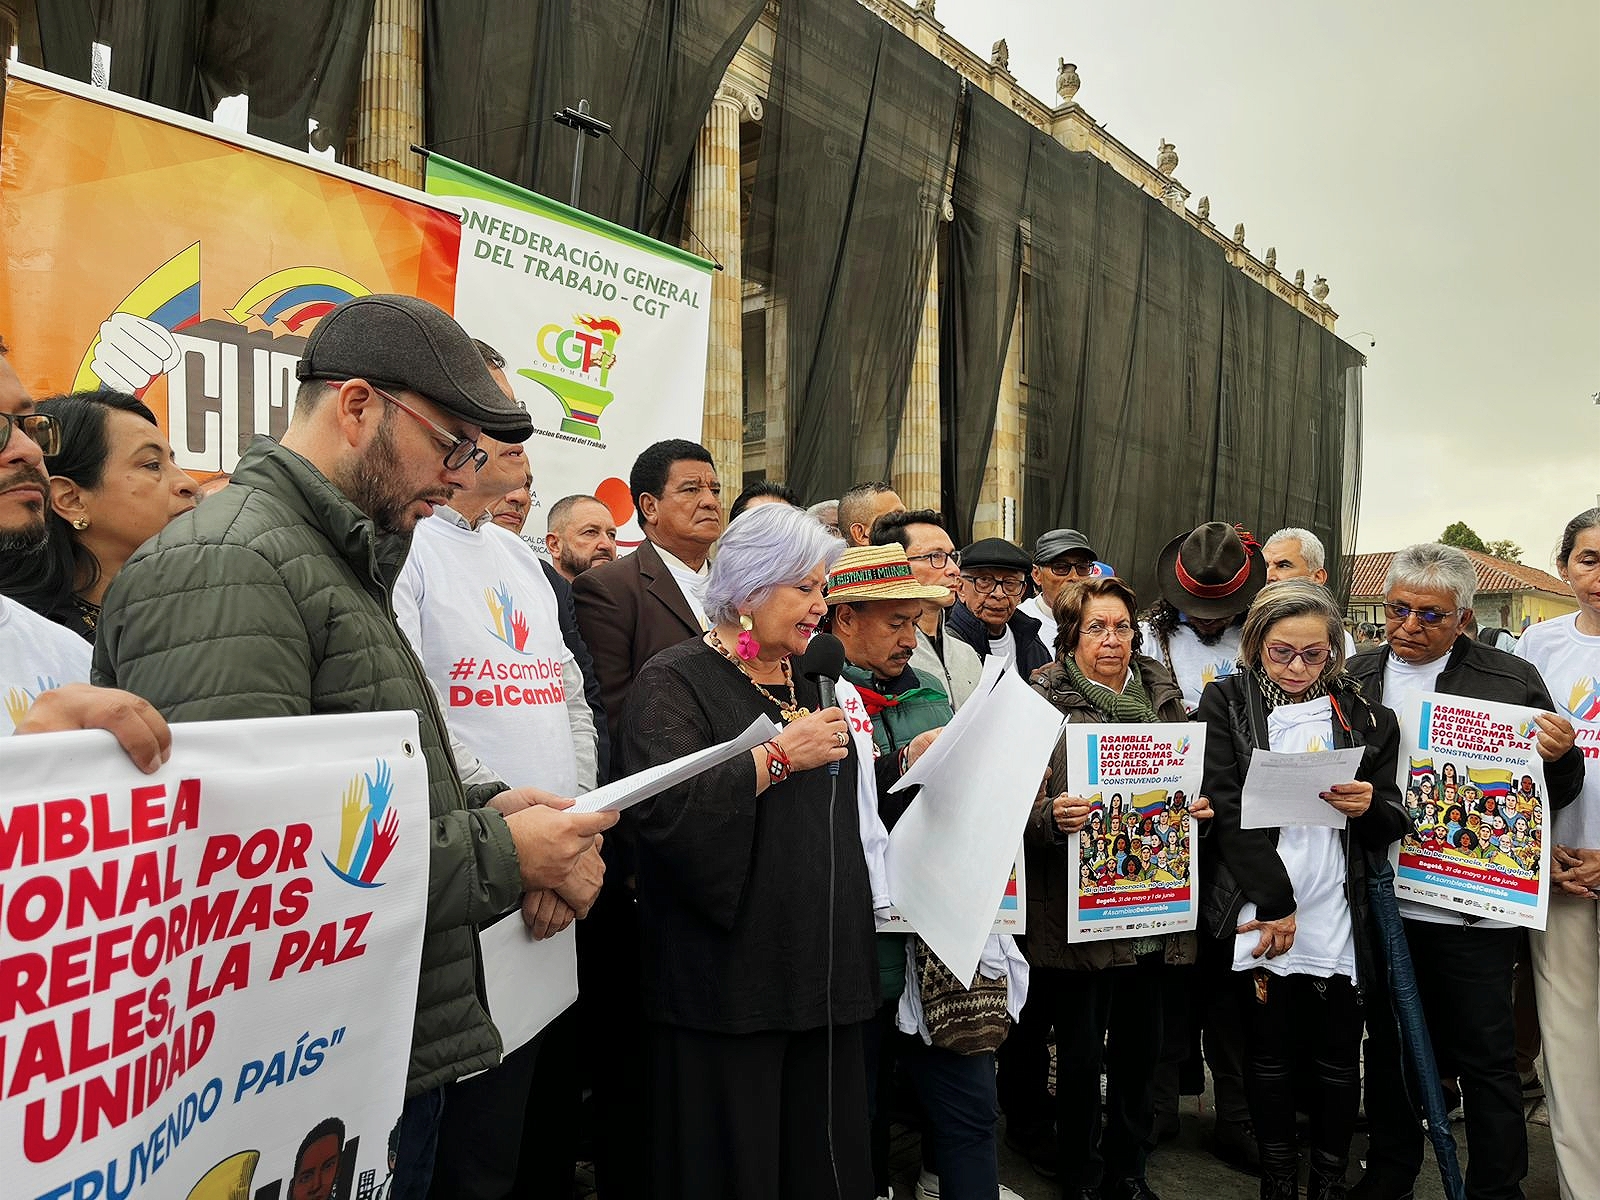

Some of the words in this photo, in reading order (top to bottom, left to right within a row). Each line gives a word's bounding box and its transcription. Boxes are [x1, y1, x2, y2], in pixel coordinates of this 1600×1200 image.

[461, 207, 618, 279] ONFEDERACIÓN
[623, 267, 700, 309] GENERAL
[474, 239, 515, 269] DEL
[524, 254, 617, 301] TRABAJO
[632, 294, 670, 320] CGT
[536, 324, 603, 373] CGT
[1433, 713, 1487, 728] NACIONAL
[1491, 723, 1513, 732] POR
[1434, 705, 1491, 721] ASAMBLEA
[1100, 735, 1153, 743] ASAMBLEA
[1432, 721, 1452, 731] LAS
[1456, 725, 1515, 740] REFORMAS
[1432, 729, 1485, 745] SOCIALES,
[1508, 741, 1531, 750] PAZ
[1432, 736, 1438, 744] Y
[1440, 738, 1453, 746] LA
[1457, 741, 1499, 753] UNIDAD
[1100, 752, 1119, 760] LAS
[1123, 751, 1172, 759] REFORMAS
[1100, 760, 1149, 768] SOCIALES,
[1109, 768, 1121, 776] LA
[1125, 767, 1159, 775] UNIDAD
[0, 844, 183, 942] ONAL
[196, 823, 313, 888] POR
[0, 877, 313, 1023] REFORMAS
[0, 978, 176, 1100] ALES,
[186, 942, 251, 1011] LA
[269, 912, 373, 981] PAZ
[24, 1010, 215, 1163] UNIDAD
